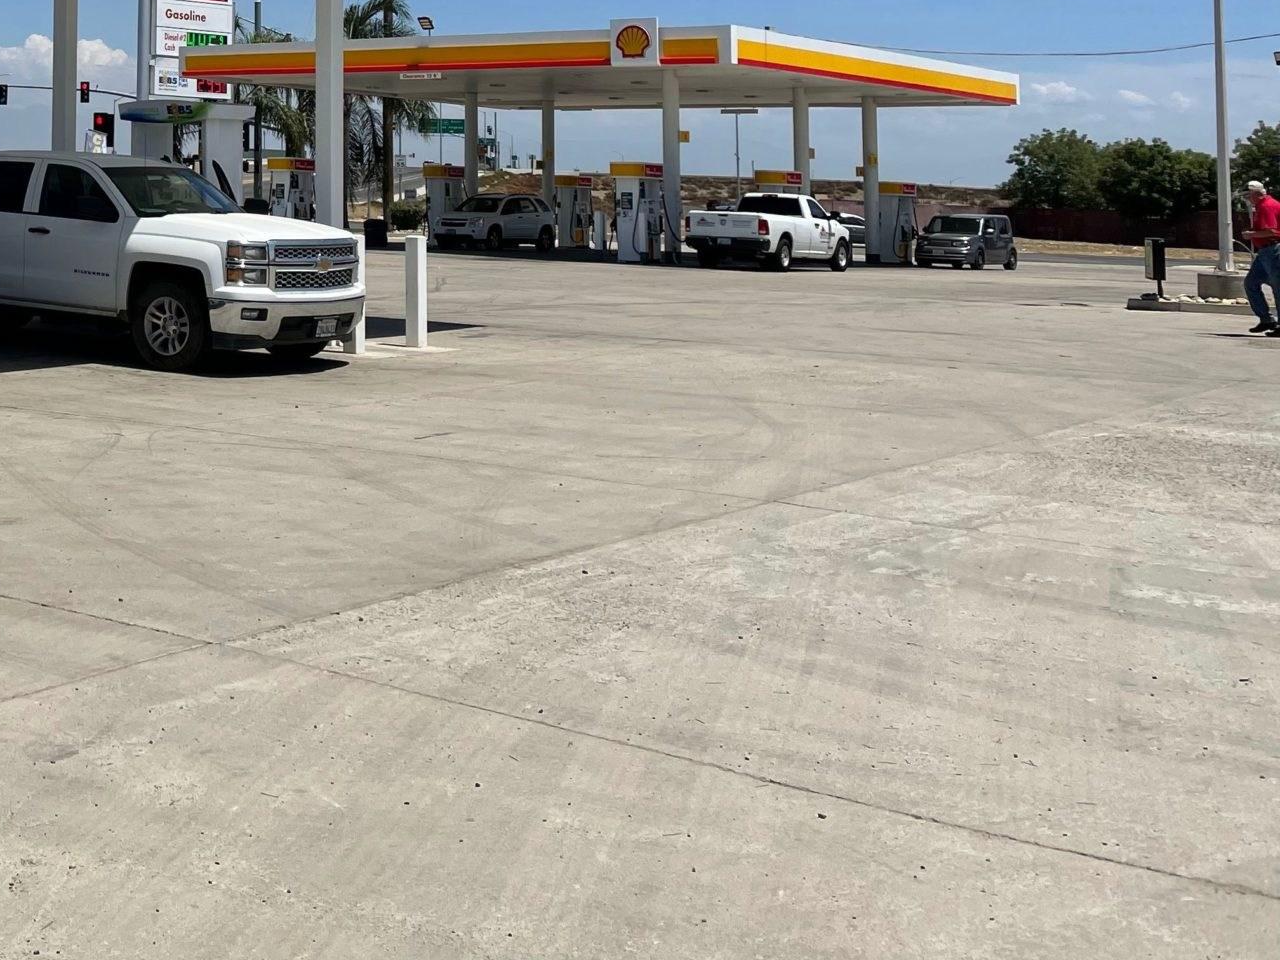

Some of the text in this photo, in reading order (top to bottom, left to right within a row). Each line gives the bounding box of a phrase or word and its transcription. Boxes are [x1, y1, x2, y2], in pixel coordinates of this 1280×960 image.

[165, 8, 207, 22] Gasoline
[164, 32, 179, 41] Diesel
[164, 42, 176, 51] Cash
